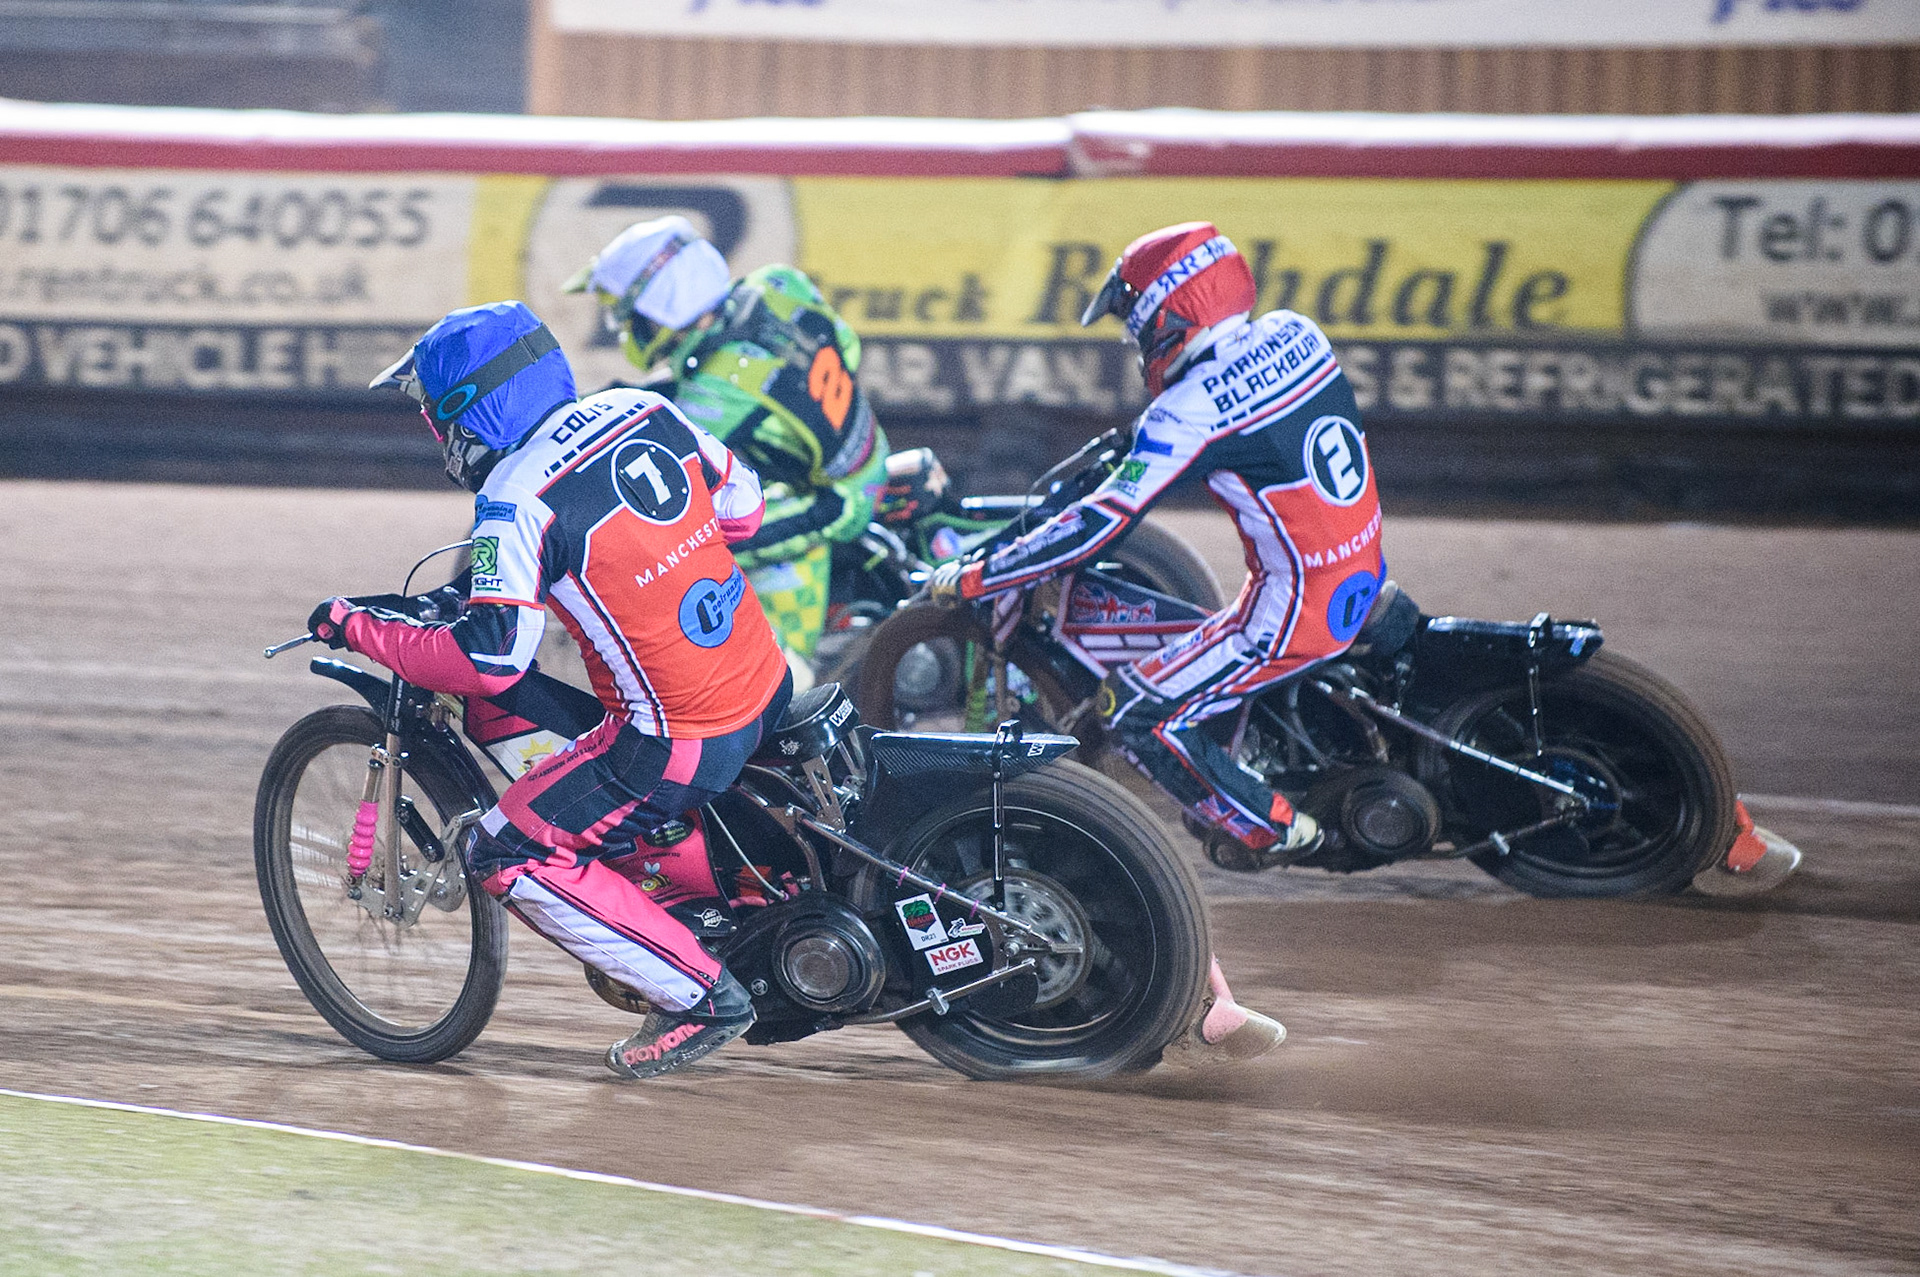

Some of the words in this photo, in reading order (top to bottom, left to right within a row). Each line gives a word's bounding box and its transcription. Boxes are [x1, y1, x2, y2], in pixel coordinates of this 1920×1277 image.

[187, 188, 432, 248] 640055
[1714, 195, 1845, 264] Tel:
[1862, 198, 1920, 264] 0
[808, 271, 988, 324] ruck
[1027, 238, 1572, 331] Rhdale
[38, 328, 298, 390] VEHICLE
[857, 344, 952, 413] AR,
[624, 451, 672, 506] 7
[1317, 421, 1362, 500] 2
[634, 516, 722, 588] MANCHEST
[929, 942, 975, 966] NGK
